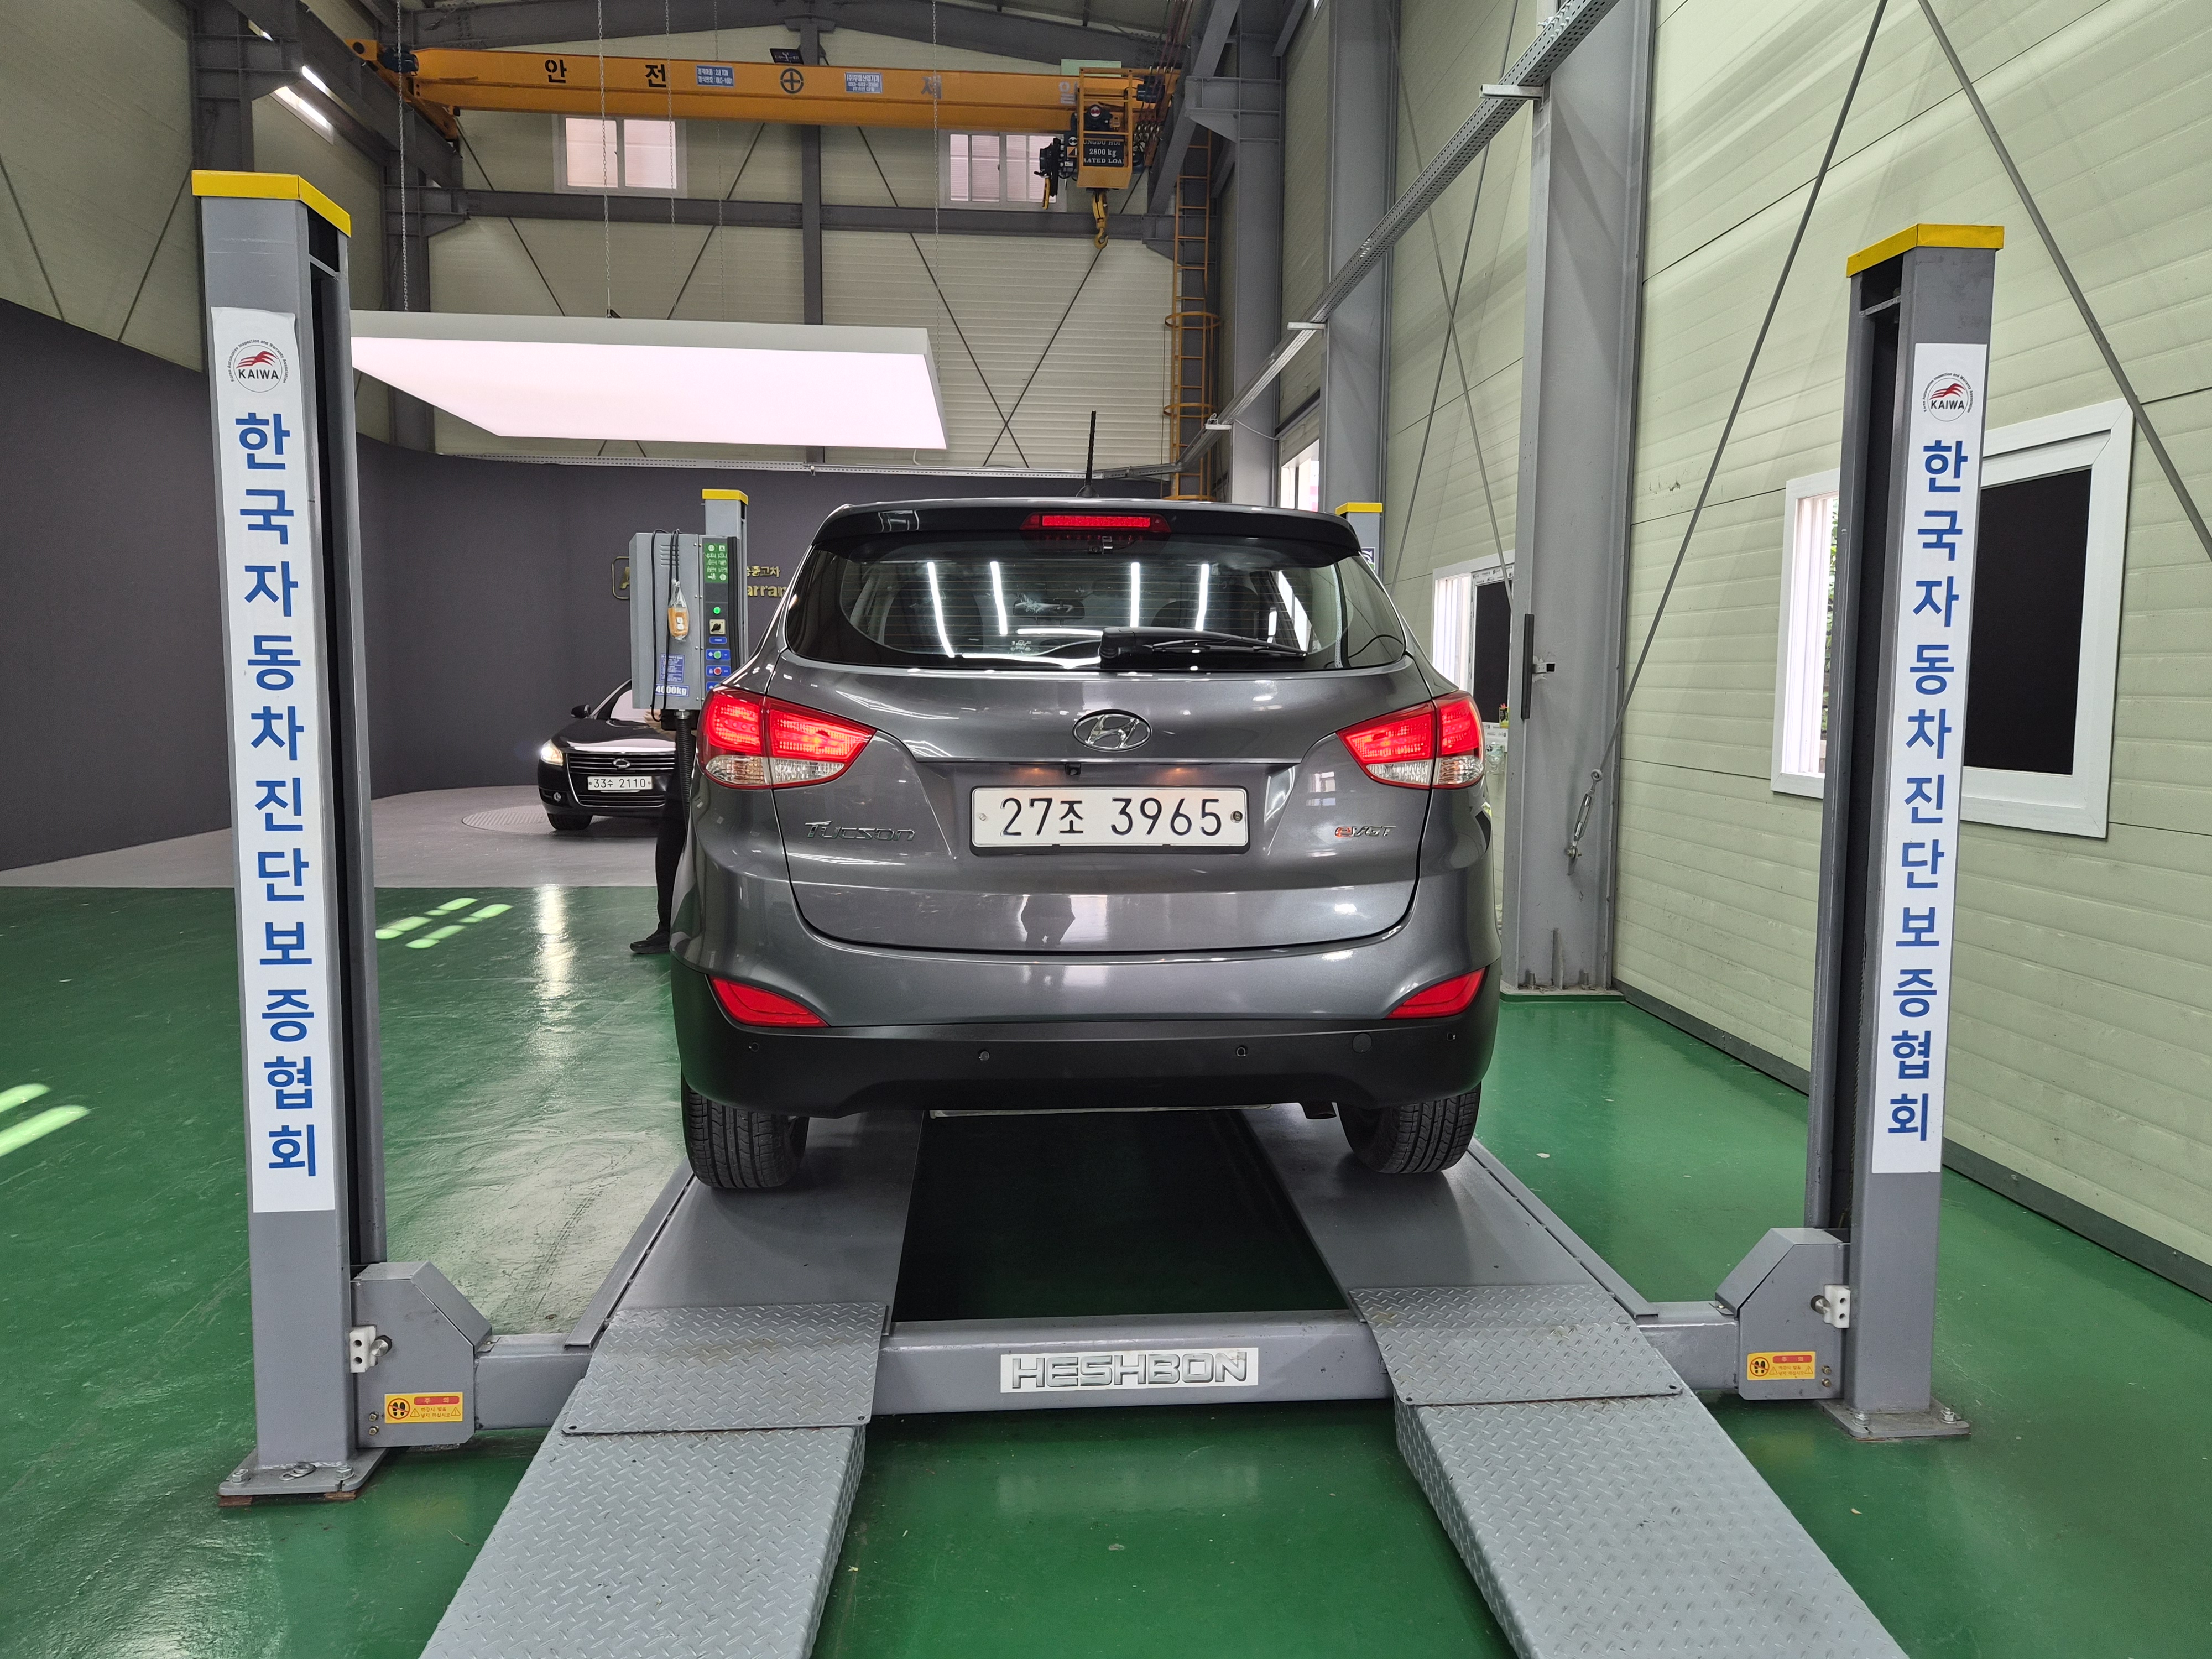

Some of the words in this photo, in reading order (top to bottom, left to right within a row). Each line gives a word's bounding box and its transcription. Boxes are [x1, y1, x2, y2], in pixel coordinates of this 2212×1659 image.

[545, 59, 567, 84] 안
[645, 64, 667, 88] 전
[921, 75, 941, 100] 제
[1108, 149, 1117, 158] kg
[238, 369, 279, 379] KAIWA
[1931, 400, 1965, 410] KAIWA
[748, 586, 787, 597] arran
[655, 685, 687, 695] 4000kg
[594, 779, 613, 788] 33수
[619, 778, 646, 788] 2110
[236, 412, 316, 1177] 한국자동차진단보증협회
[1887, 440, 1968, 1141] 한국자동차진단보증협회
[1000, 797, 1084, 837] 27조
[1110, 797, 1222, 837] 3965
[1011, 1352, 1248, 1389] HESHBON
